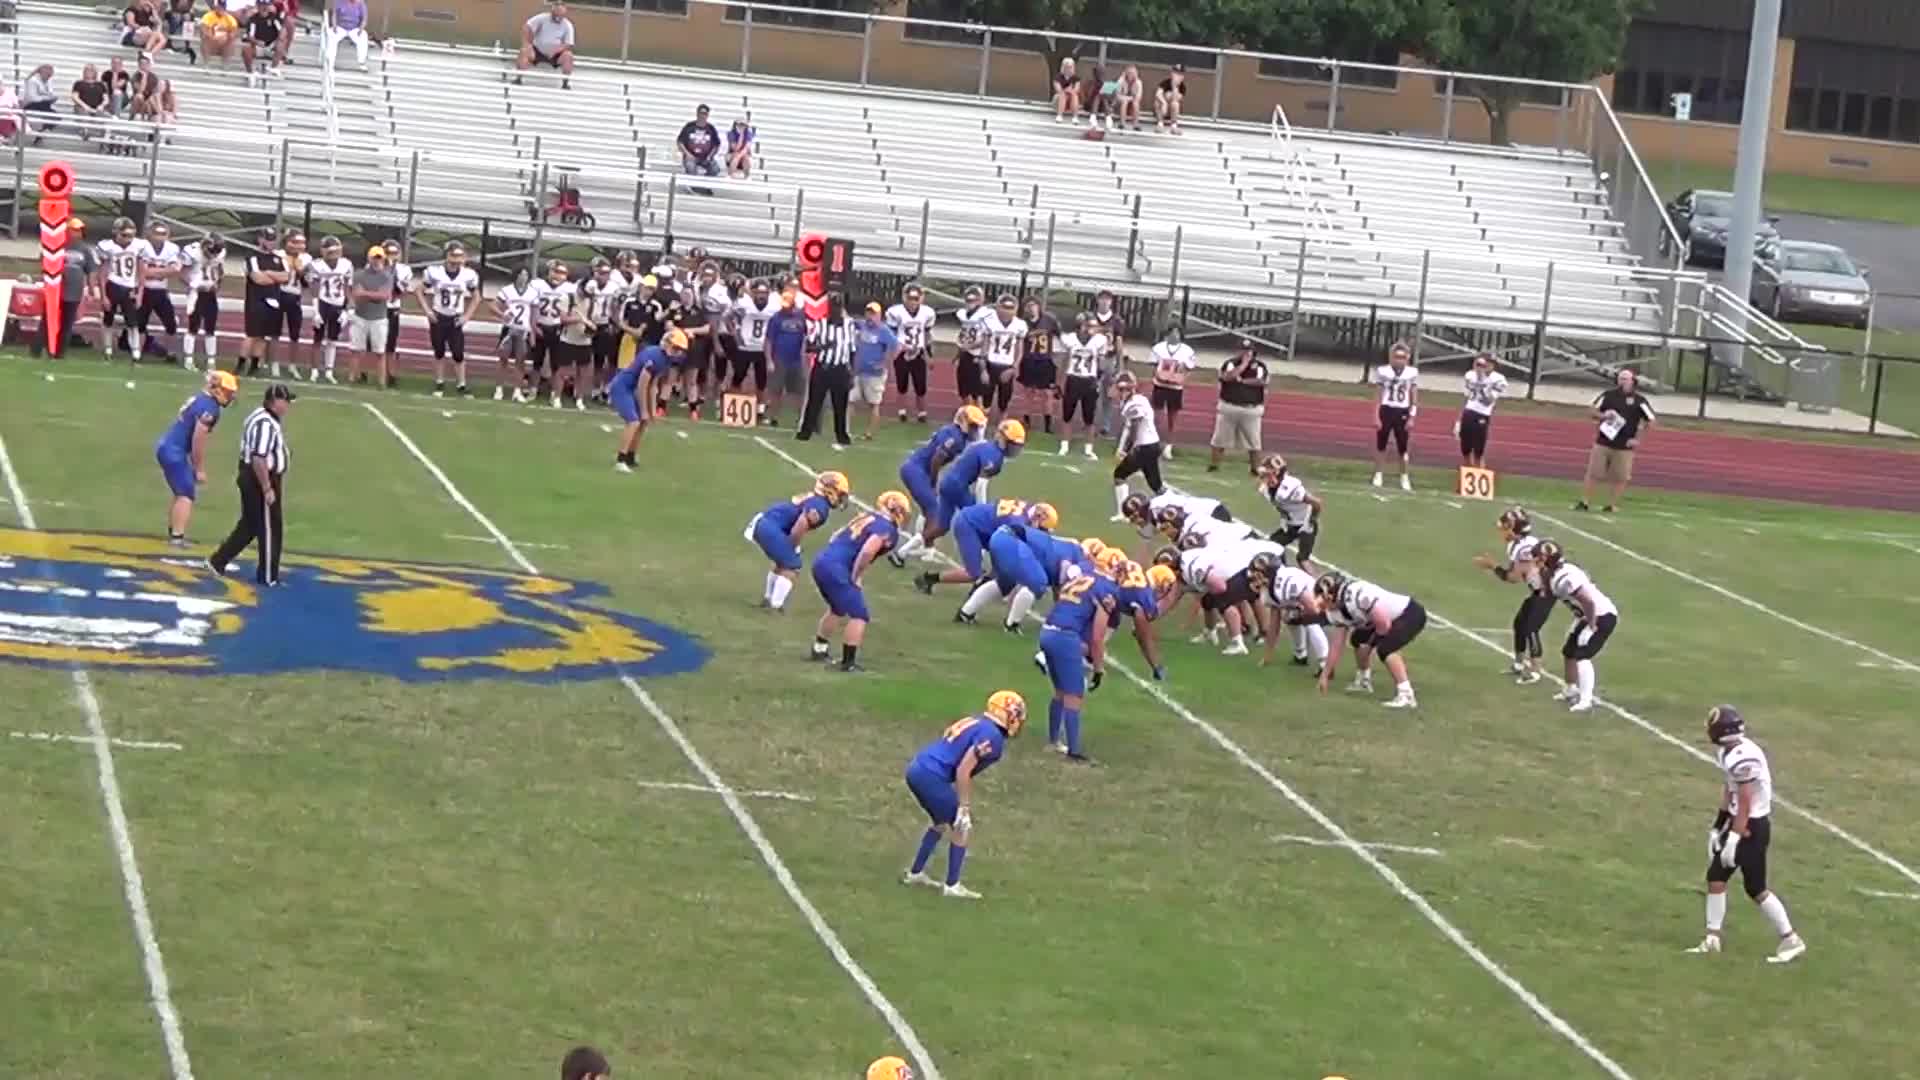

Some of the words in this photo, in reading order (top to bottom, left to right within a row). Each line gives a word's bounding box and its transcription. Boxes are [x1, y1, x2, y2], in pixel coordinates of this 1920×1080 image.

[115, 257, 134, 278] 19
[513, 304, 525, 325] 2
[752, 319, 764, 338] 8
[994, 336, 1013, 355] 14
[726, 398, 753, 425] 40
[1464, 472, 1490, 497] 30
